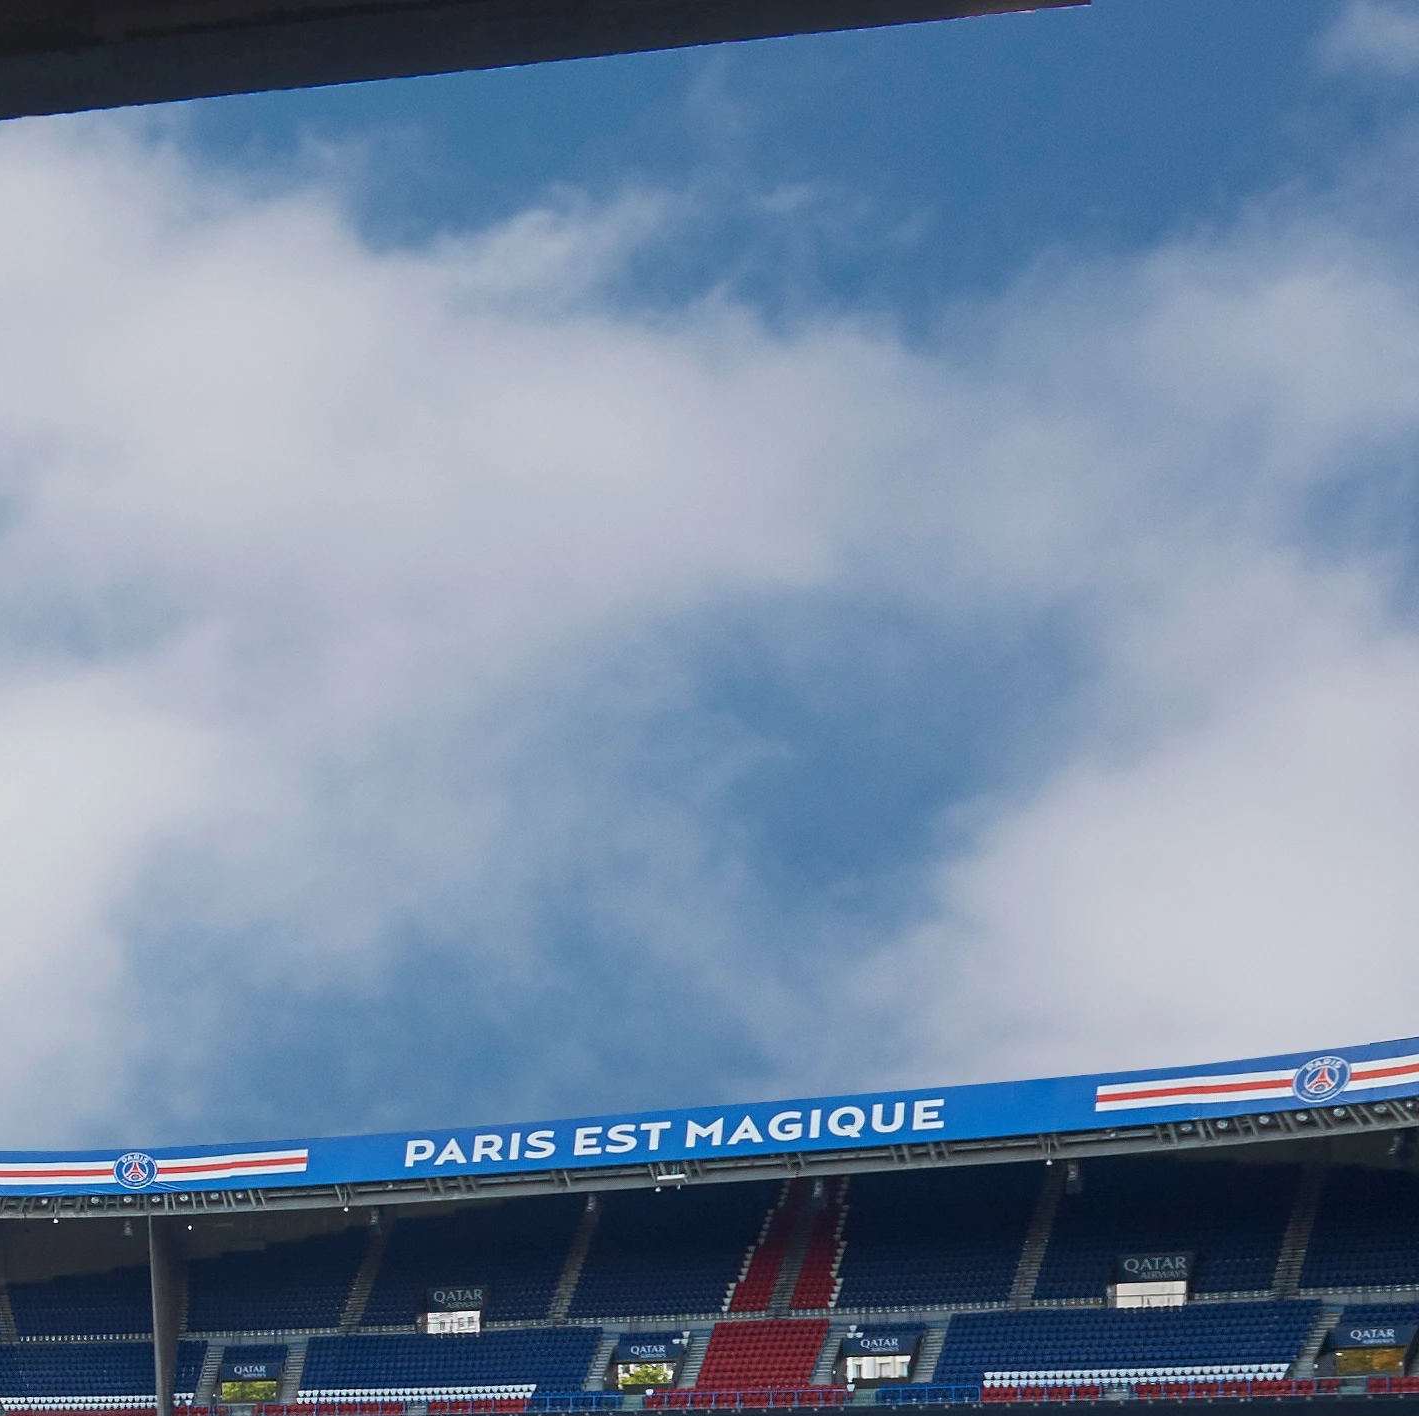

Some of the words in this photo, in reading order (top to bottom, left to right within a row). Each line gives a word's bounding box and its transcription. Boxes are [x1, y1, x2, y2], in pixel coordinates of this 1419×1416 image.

[405, 1130, 556, 1167] PARIS
[573, 1121, 672, 1156] EST
[685, 1098, 945, 1148] MAGIQUE
[1124, 1256, 1186, 1274] QATAR
[434, 1289, 483, 1303] QATAR
[1350, 1329, 1395, 1341] QATAR
[630, 1344, 666, 1355] QATAR
[860, 1338, 899, 1349] QATAR
[233, 1365, 266, 1375] QATAR
